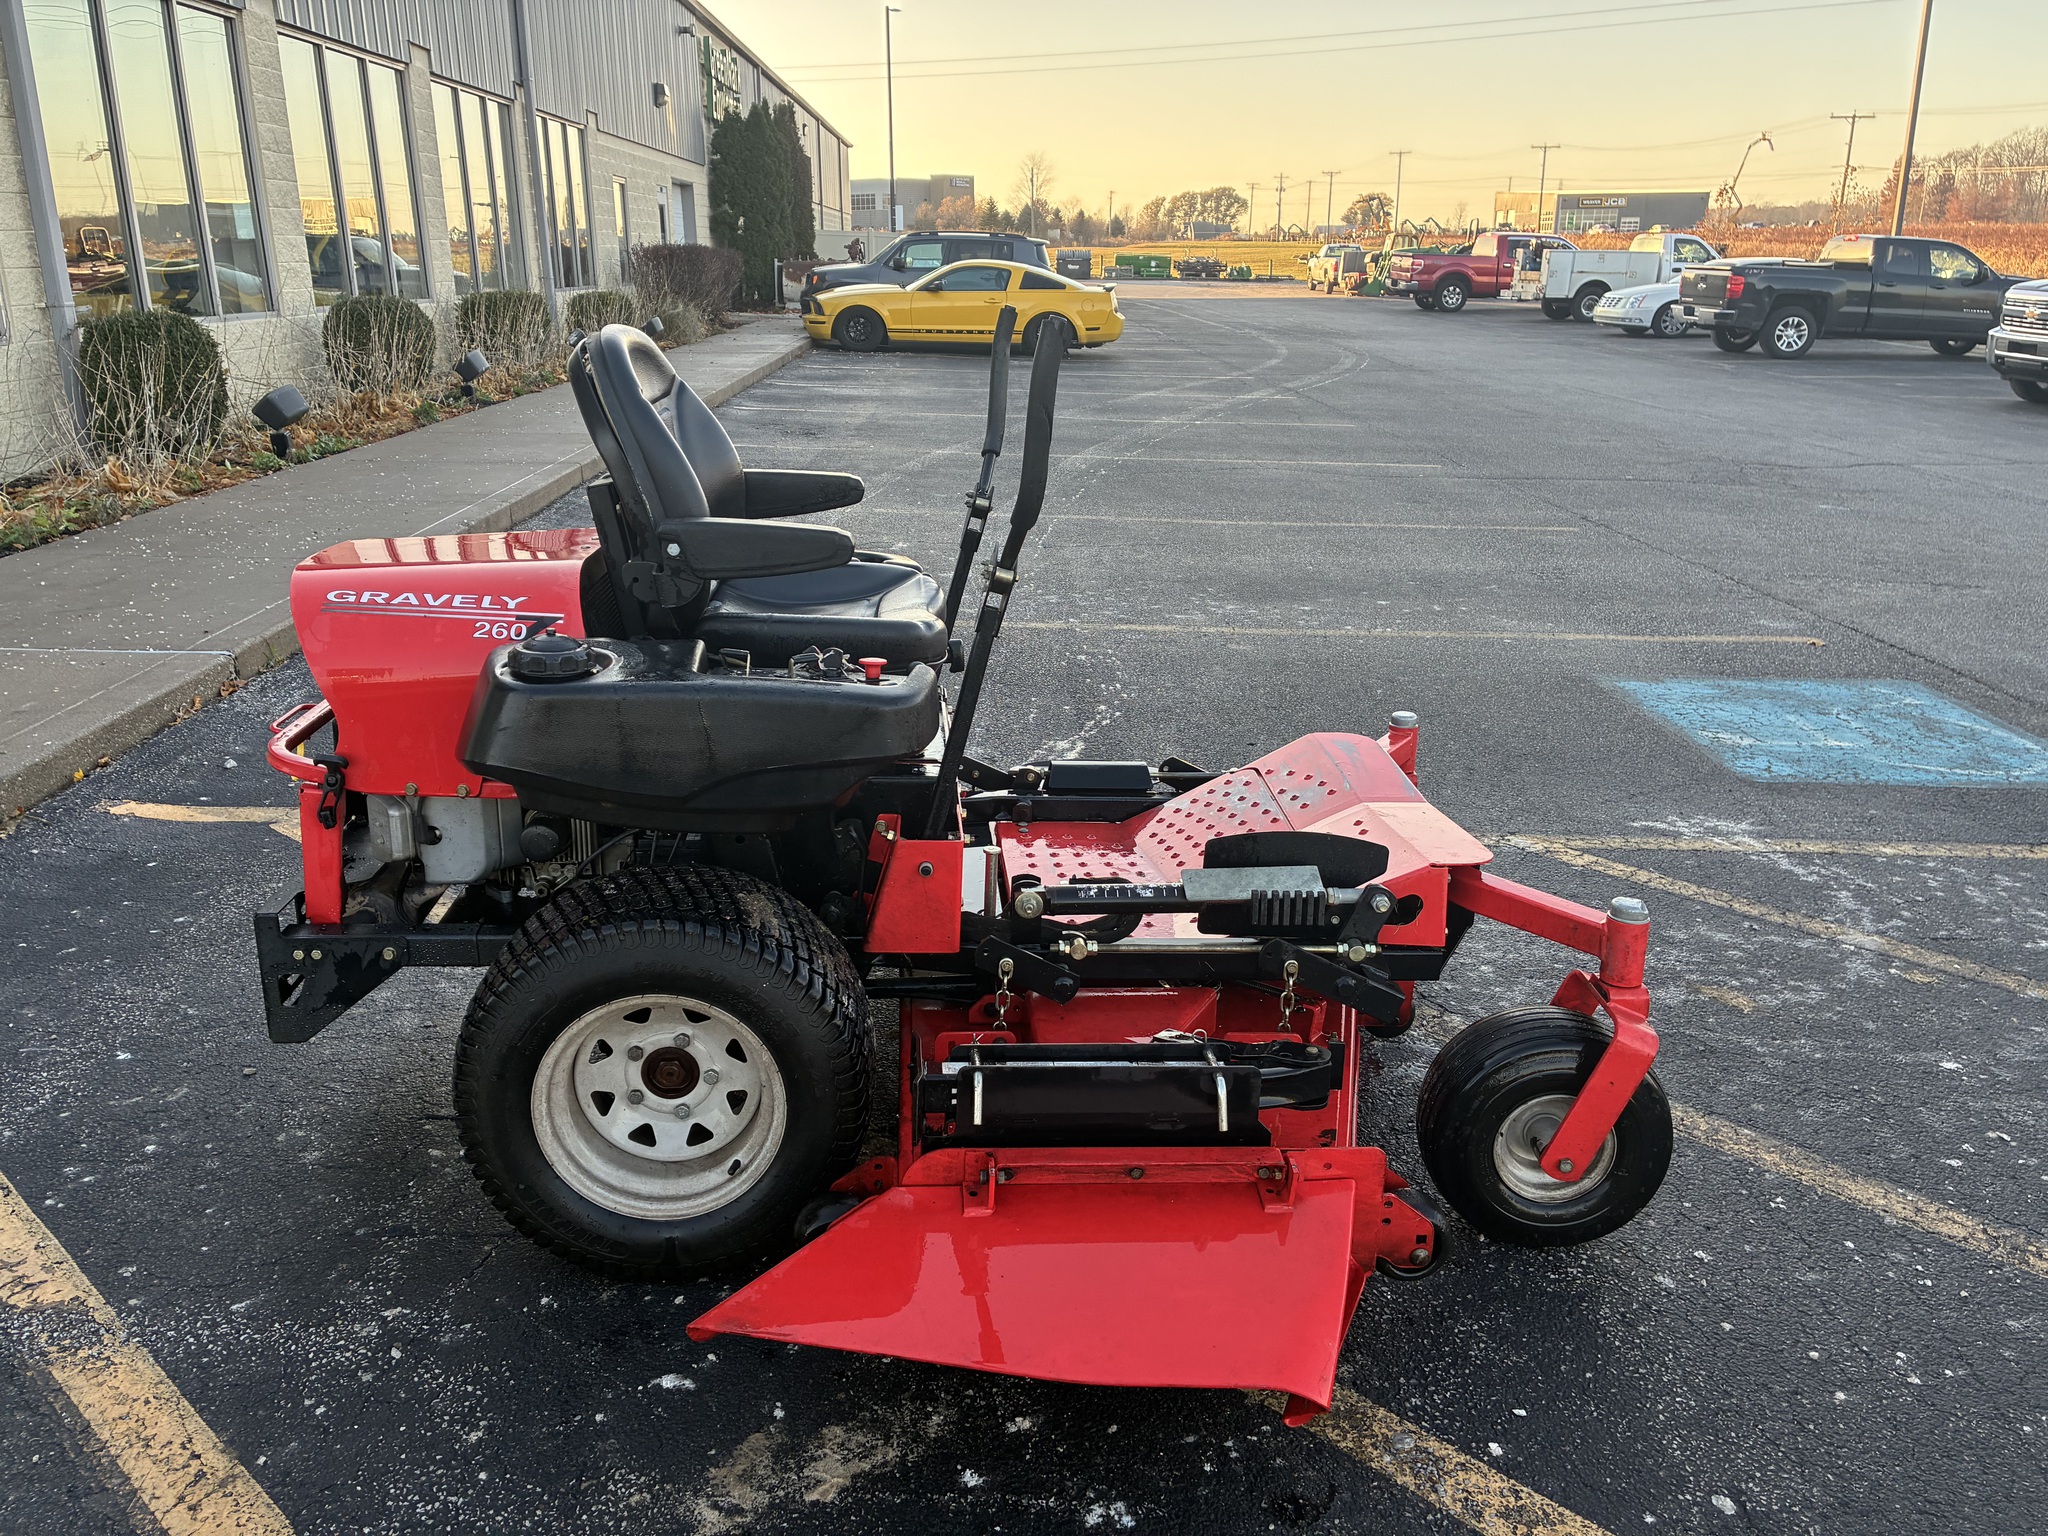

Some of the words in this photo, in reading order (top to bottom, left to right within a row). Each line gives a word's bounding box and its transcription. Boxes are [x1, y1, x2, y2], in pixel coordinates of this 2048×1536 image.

[1604, 197, 1626, 206] JCB
[326, 590, 530, 609] GRAVELY
[472, 621, 527, 641] 260
